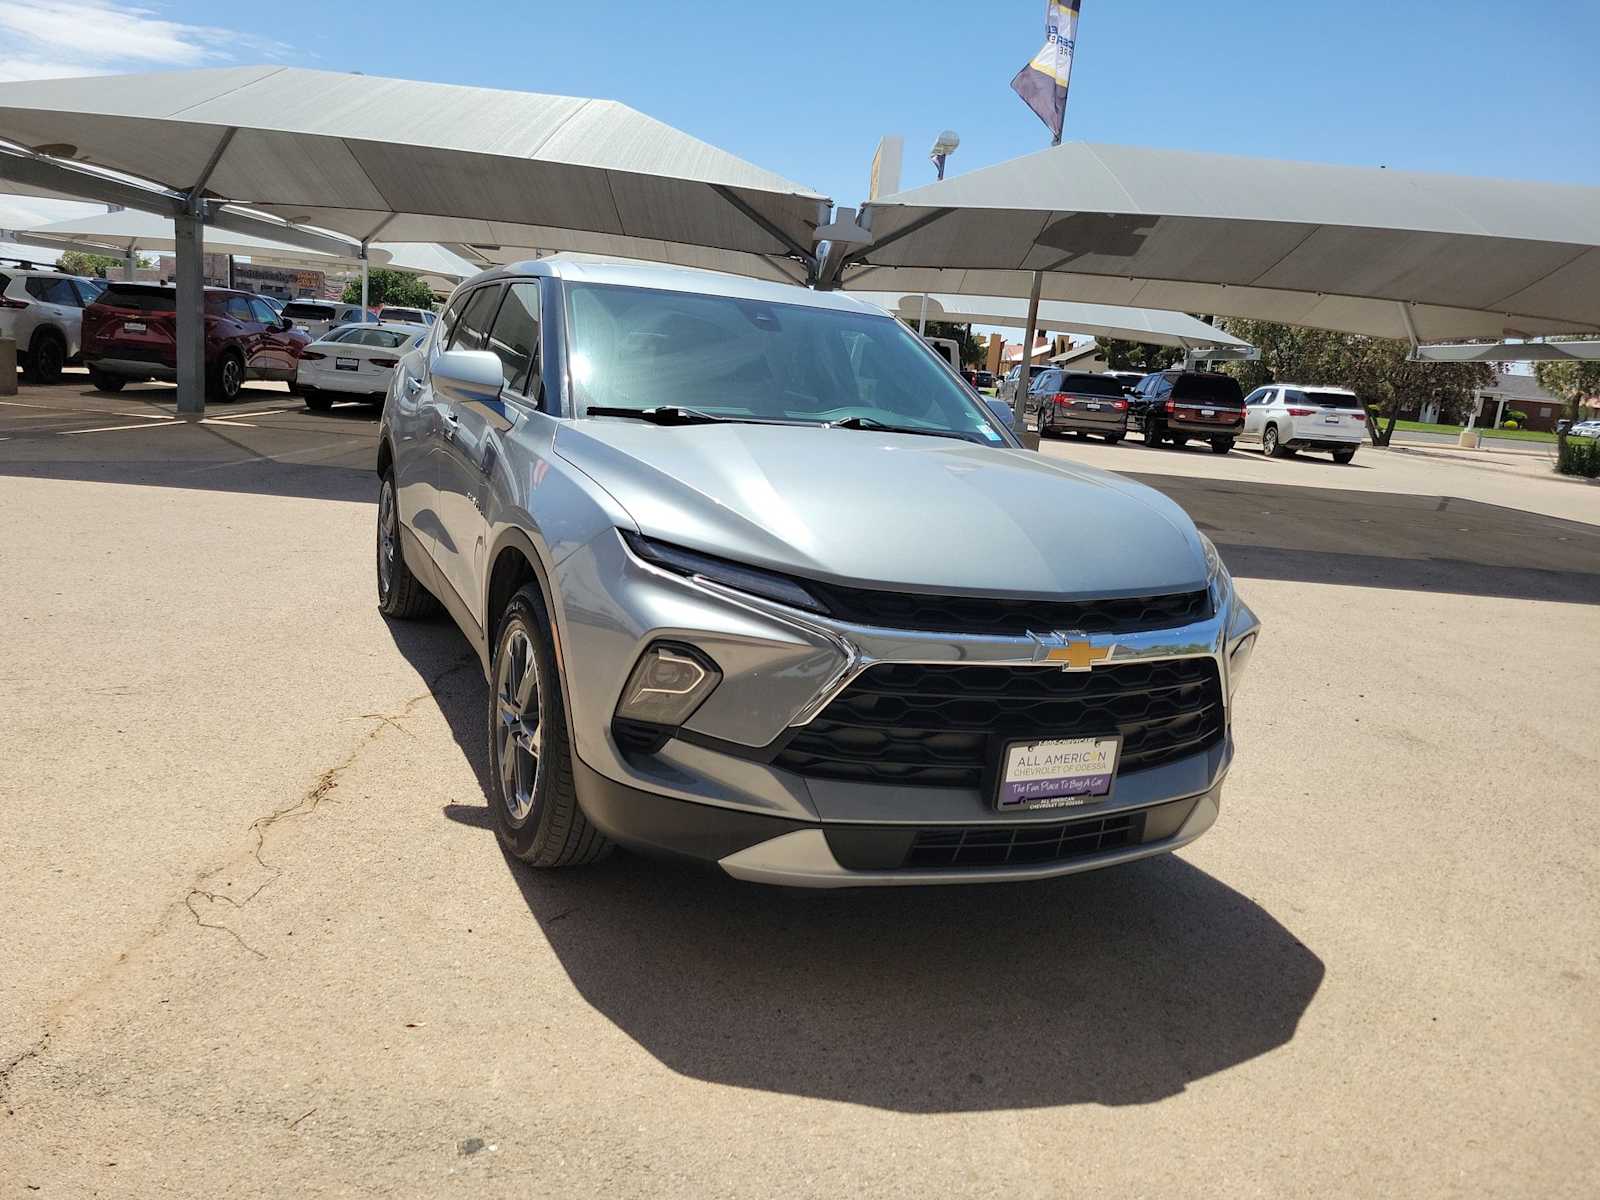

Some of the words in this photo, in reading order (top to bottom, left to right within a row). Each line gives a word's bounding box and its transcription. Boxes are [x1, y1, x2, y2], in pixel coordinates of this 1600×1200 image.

[1017, 756, 1041, 767] ALL
[1045, 751, 1107, 765] AMERICN
[1014, 765, 1061, 777] CHEVROLET
[1063, 763, 1074, 773] OF
[1075, 763, 1106, 772] ODESSA
[1012, 783, 1026, 794] The
[1026, 782, 1040, 792] Fun
[1041, 780, 1060, 792] Place
[1061, 779, 1069, 790] To
[1069, 778, 1083, 791] Buy
[1083, 778, 1090, 788] A
[1090, 777, 1103, 787] Car
